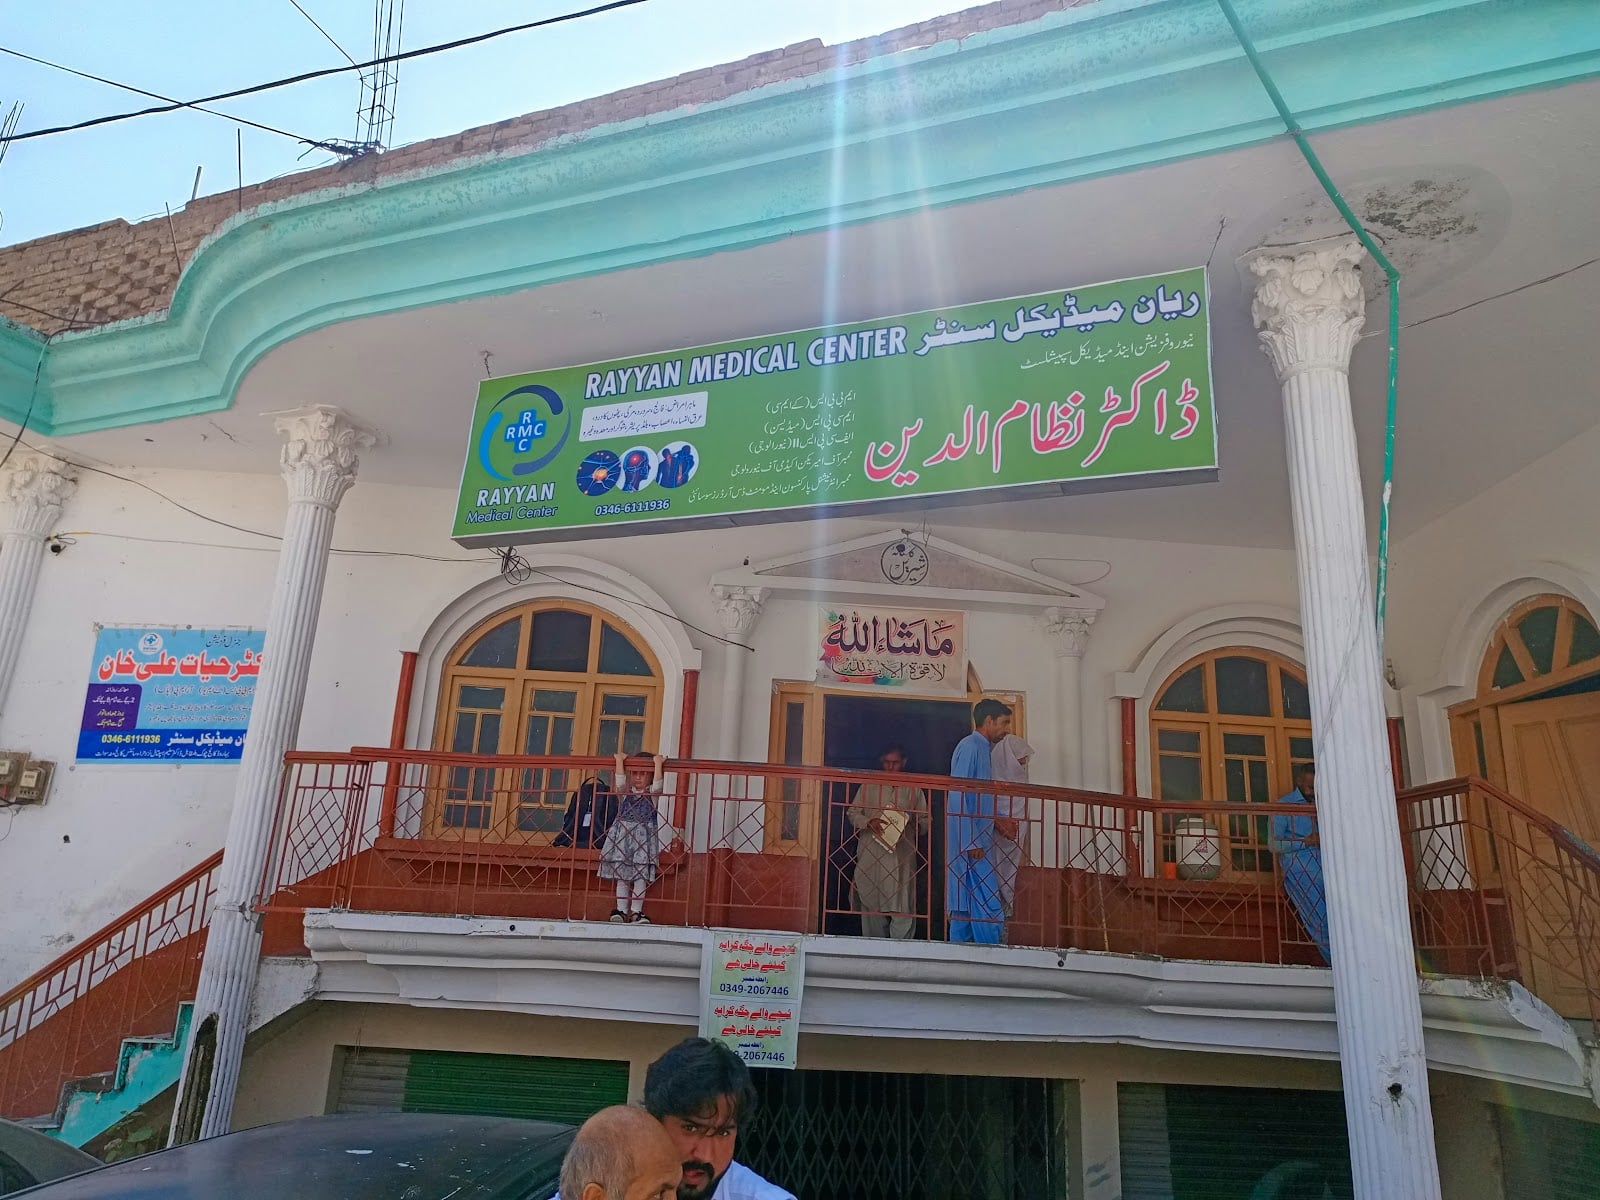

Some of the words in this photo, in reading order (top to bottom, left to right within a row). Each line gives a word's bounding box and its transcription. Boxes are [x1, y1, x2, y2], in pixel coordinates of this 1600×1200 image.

[1002, 292, 1125, 342] میڈیکل
[1132, 284, 1200, 324] ریان
[914, 317, 996, 355] سنٹر
[584, 360, 682, 399] RAYYAN
[688, 342, 799, 384] MEDICAL
[807, 325, 907, 366] CENTER
[1020, 350, 1072, 370] سپیشلسٹ
[1081, 360, 1200, 468] ڈاکٹر
[864, 402, 989, 486] الدین
[992, 391, 1085, 473] نظام
[476, 482, 555, 507] RAYYAN
[595, 499, 670, 516] 0346-6111936
[465, 505, 513, 524] Medical
[516, 504, 558, 520] Center
[99, 650, 137, 682] خان
[136, 651, 178, 682] علی
[178, 650, 232, 681] حیات
[101, 734, 161, 744] 0346-6111936
[167, 731, 194, 747] سنٹر
[195, 731, 233, 747] میڈیکل
[741, 959, 759, 971] خالی
[720, 983, 789, 996] 0349-2067446
[736, 1024, 755, 1036] خالی
